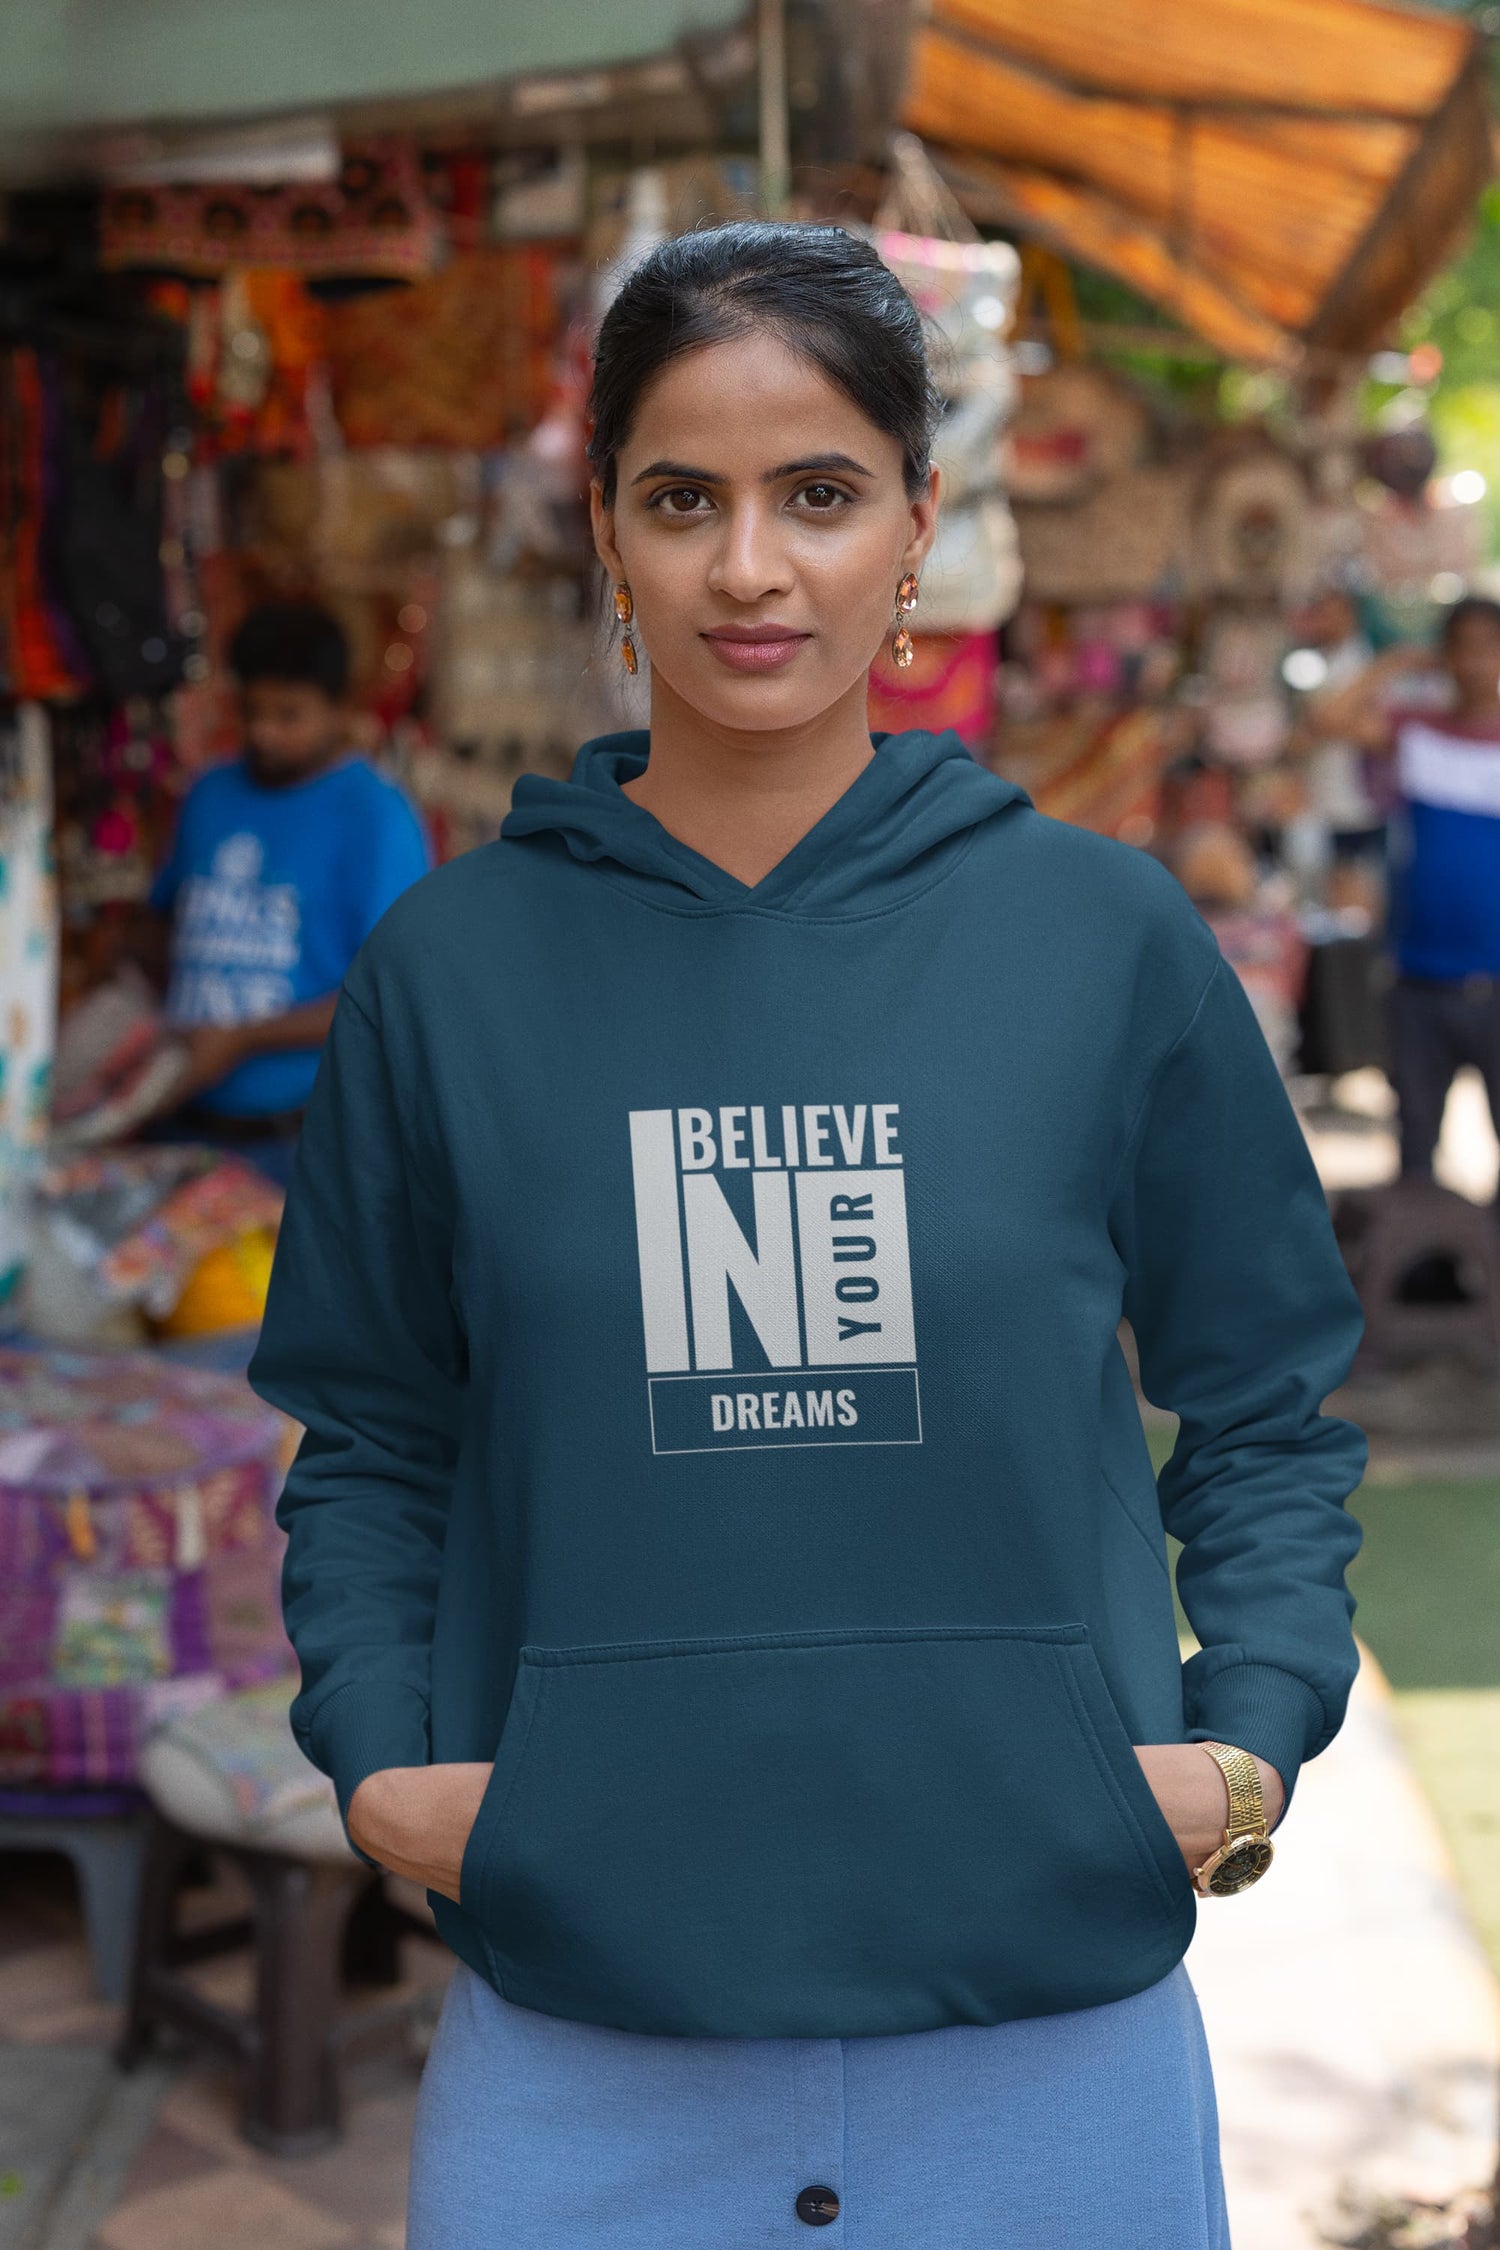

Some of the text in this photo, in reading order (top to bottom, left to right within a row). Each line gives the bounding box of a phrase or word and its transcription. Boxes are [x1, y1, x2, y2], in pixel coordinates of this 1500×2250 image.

[678, 1104, 904, 1170] BELIEVE
[629, 1109, 802, 1372] IN
[830, 1193, 882, 1342] YOUR
[711, 1391, 858, 1432] DREAMS
